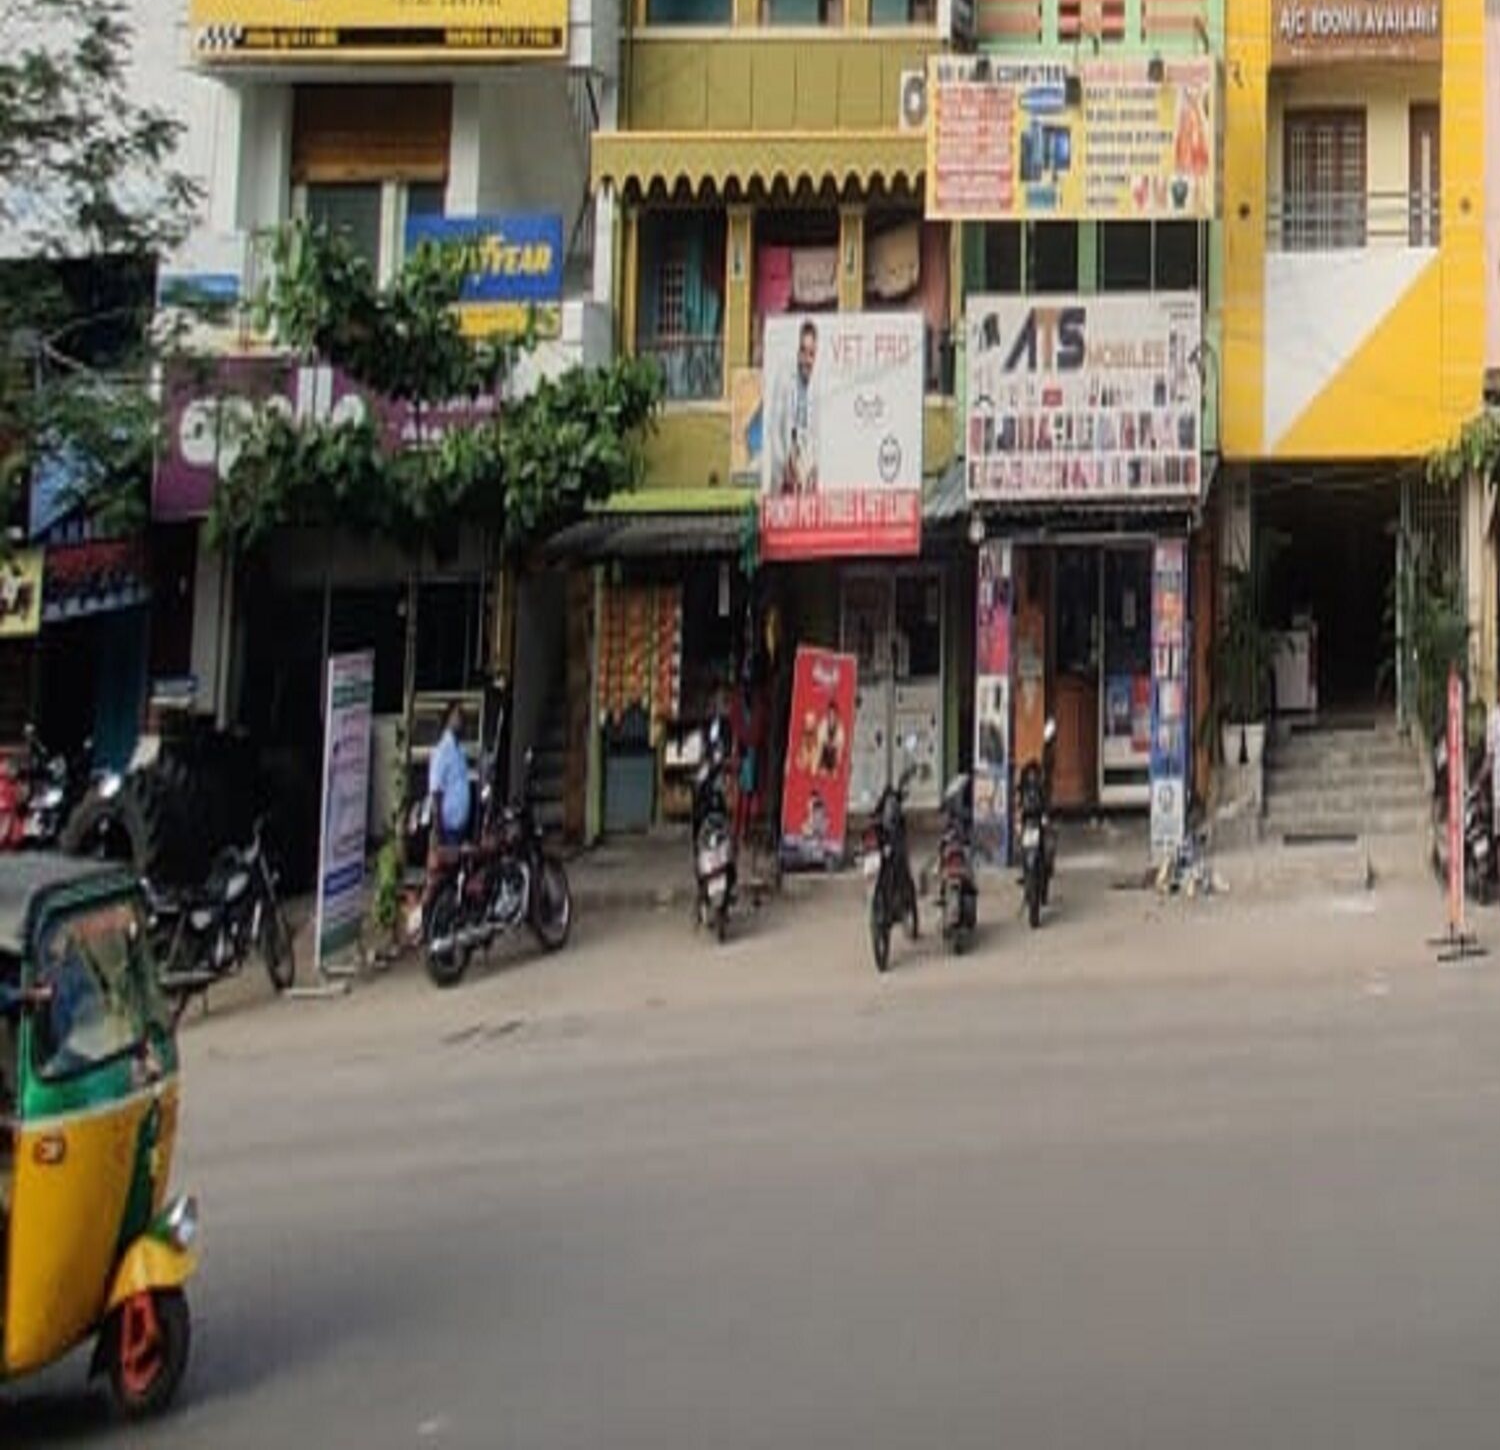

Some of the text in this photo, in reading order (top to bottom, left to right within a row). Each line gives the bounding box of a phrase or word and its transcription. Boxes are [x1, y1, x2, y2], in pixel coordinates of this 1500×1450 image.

[830, 334, 910, 367] VET PRO
[1002, 306, 1086, 373] ATS
